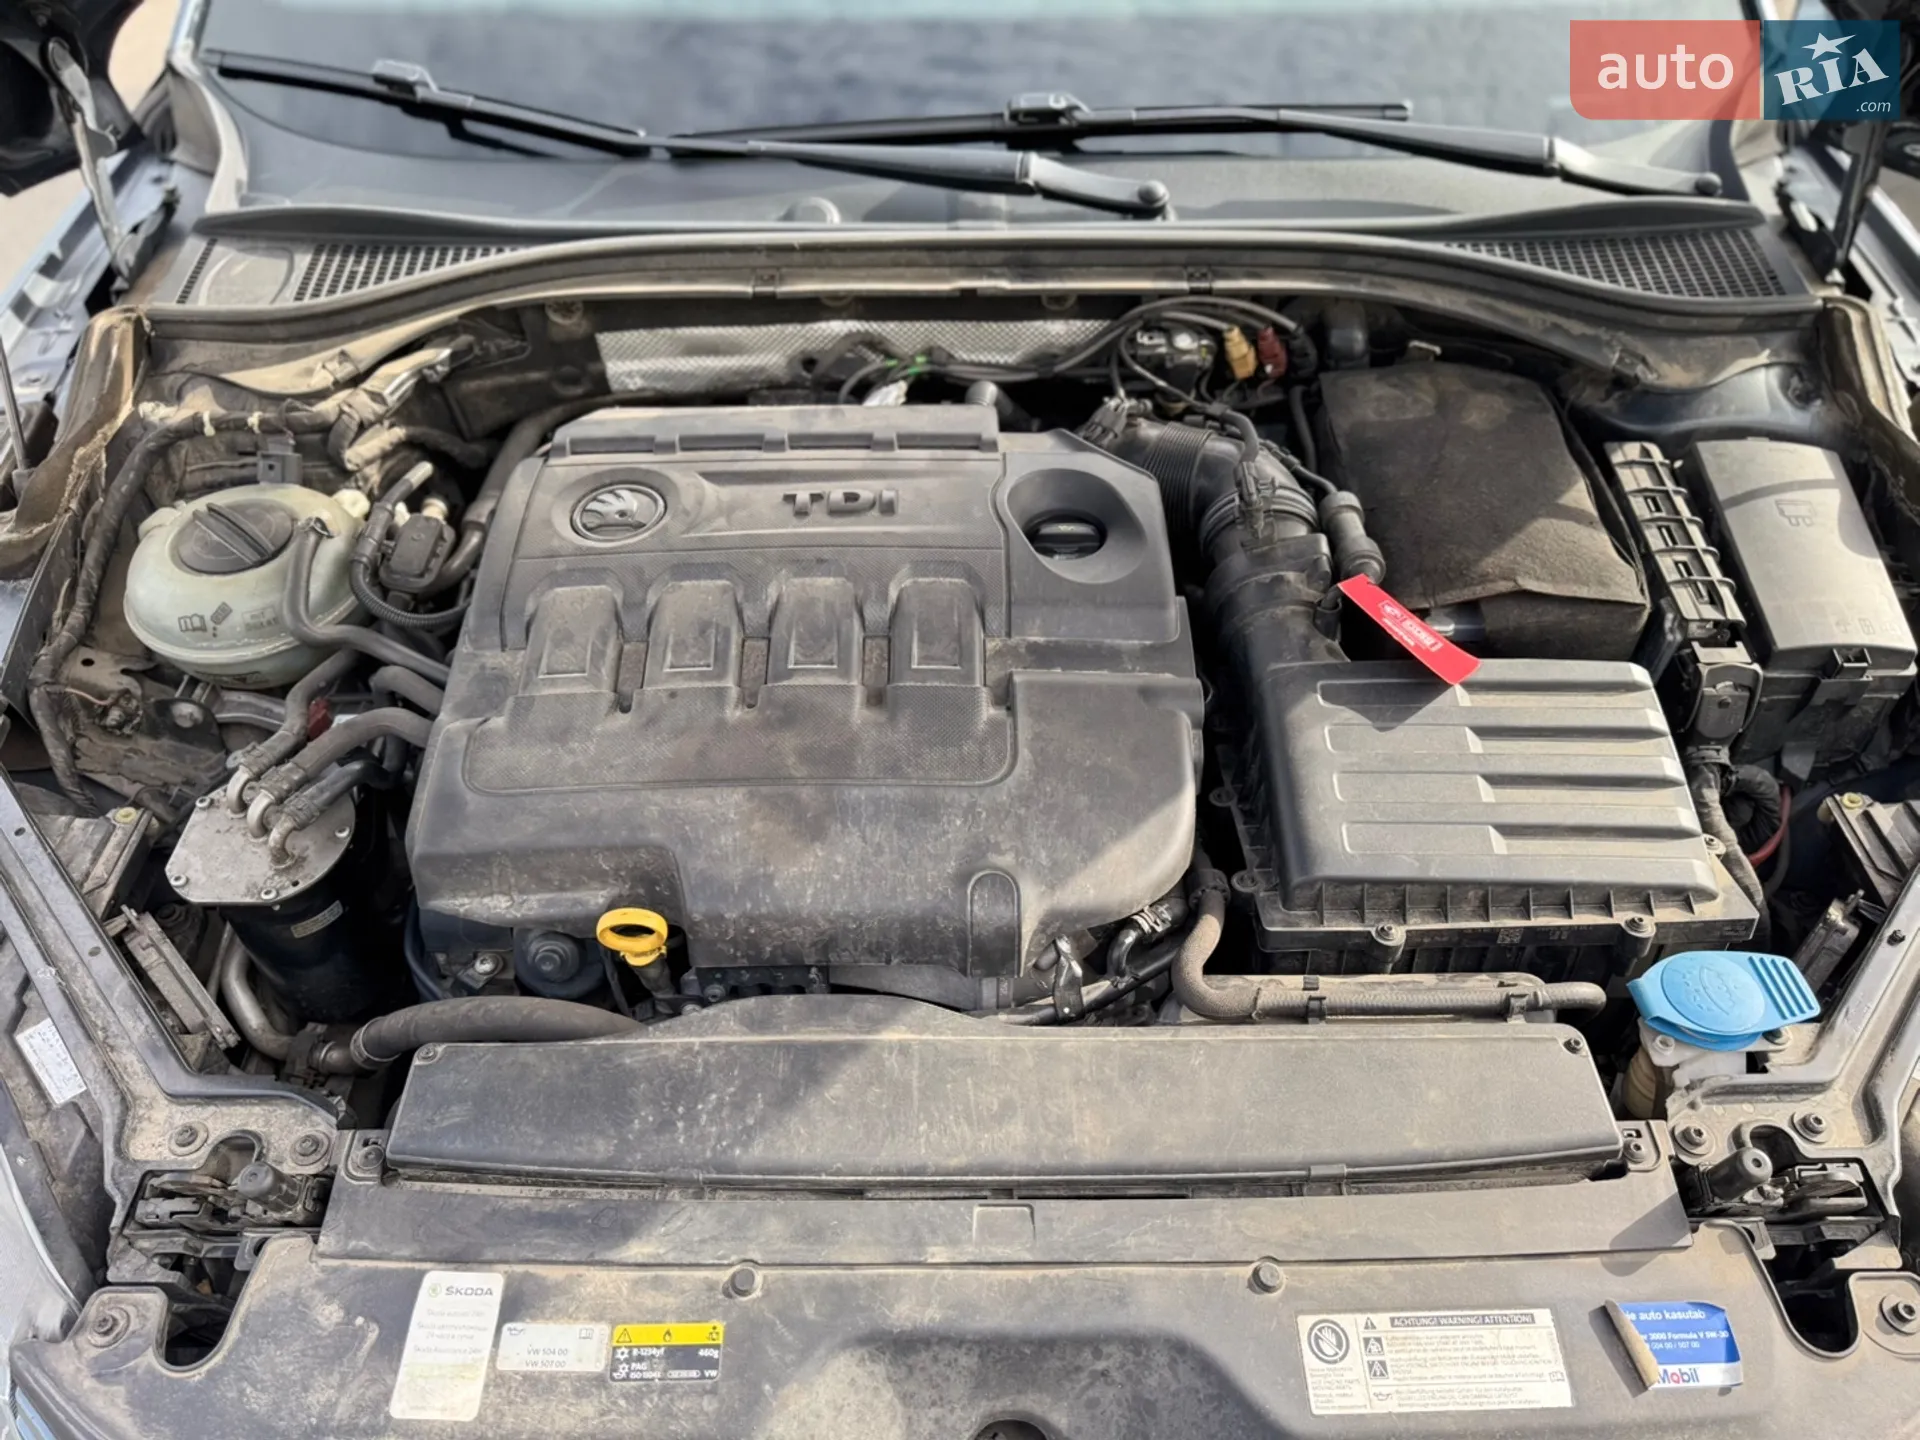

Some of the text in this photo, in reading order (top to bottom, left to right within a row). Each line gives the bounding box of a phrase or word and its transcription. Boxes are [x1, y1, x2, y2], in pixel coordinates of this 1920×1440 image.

[1638, 1310, 1662, 1320] auto
[1663, 1309, 1706, 1320] kasutab
[1484, 1314, 1533, 1325] ATTENTION!
[1667, 1331, 1698, 1340] Formula
[526, 1347, 569, 1356] VW 504 00
[525, 1359, 567, 1368] VW 507 00
[631, 1362, 648, 1371] PAG
[703, 1370, 719, 1378] VW
